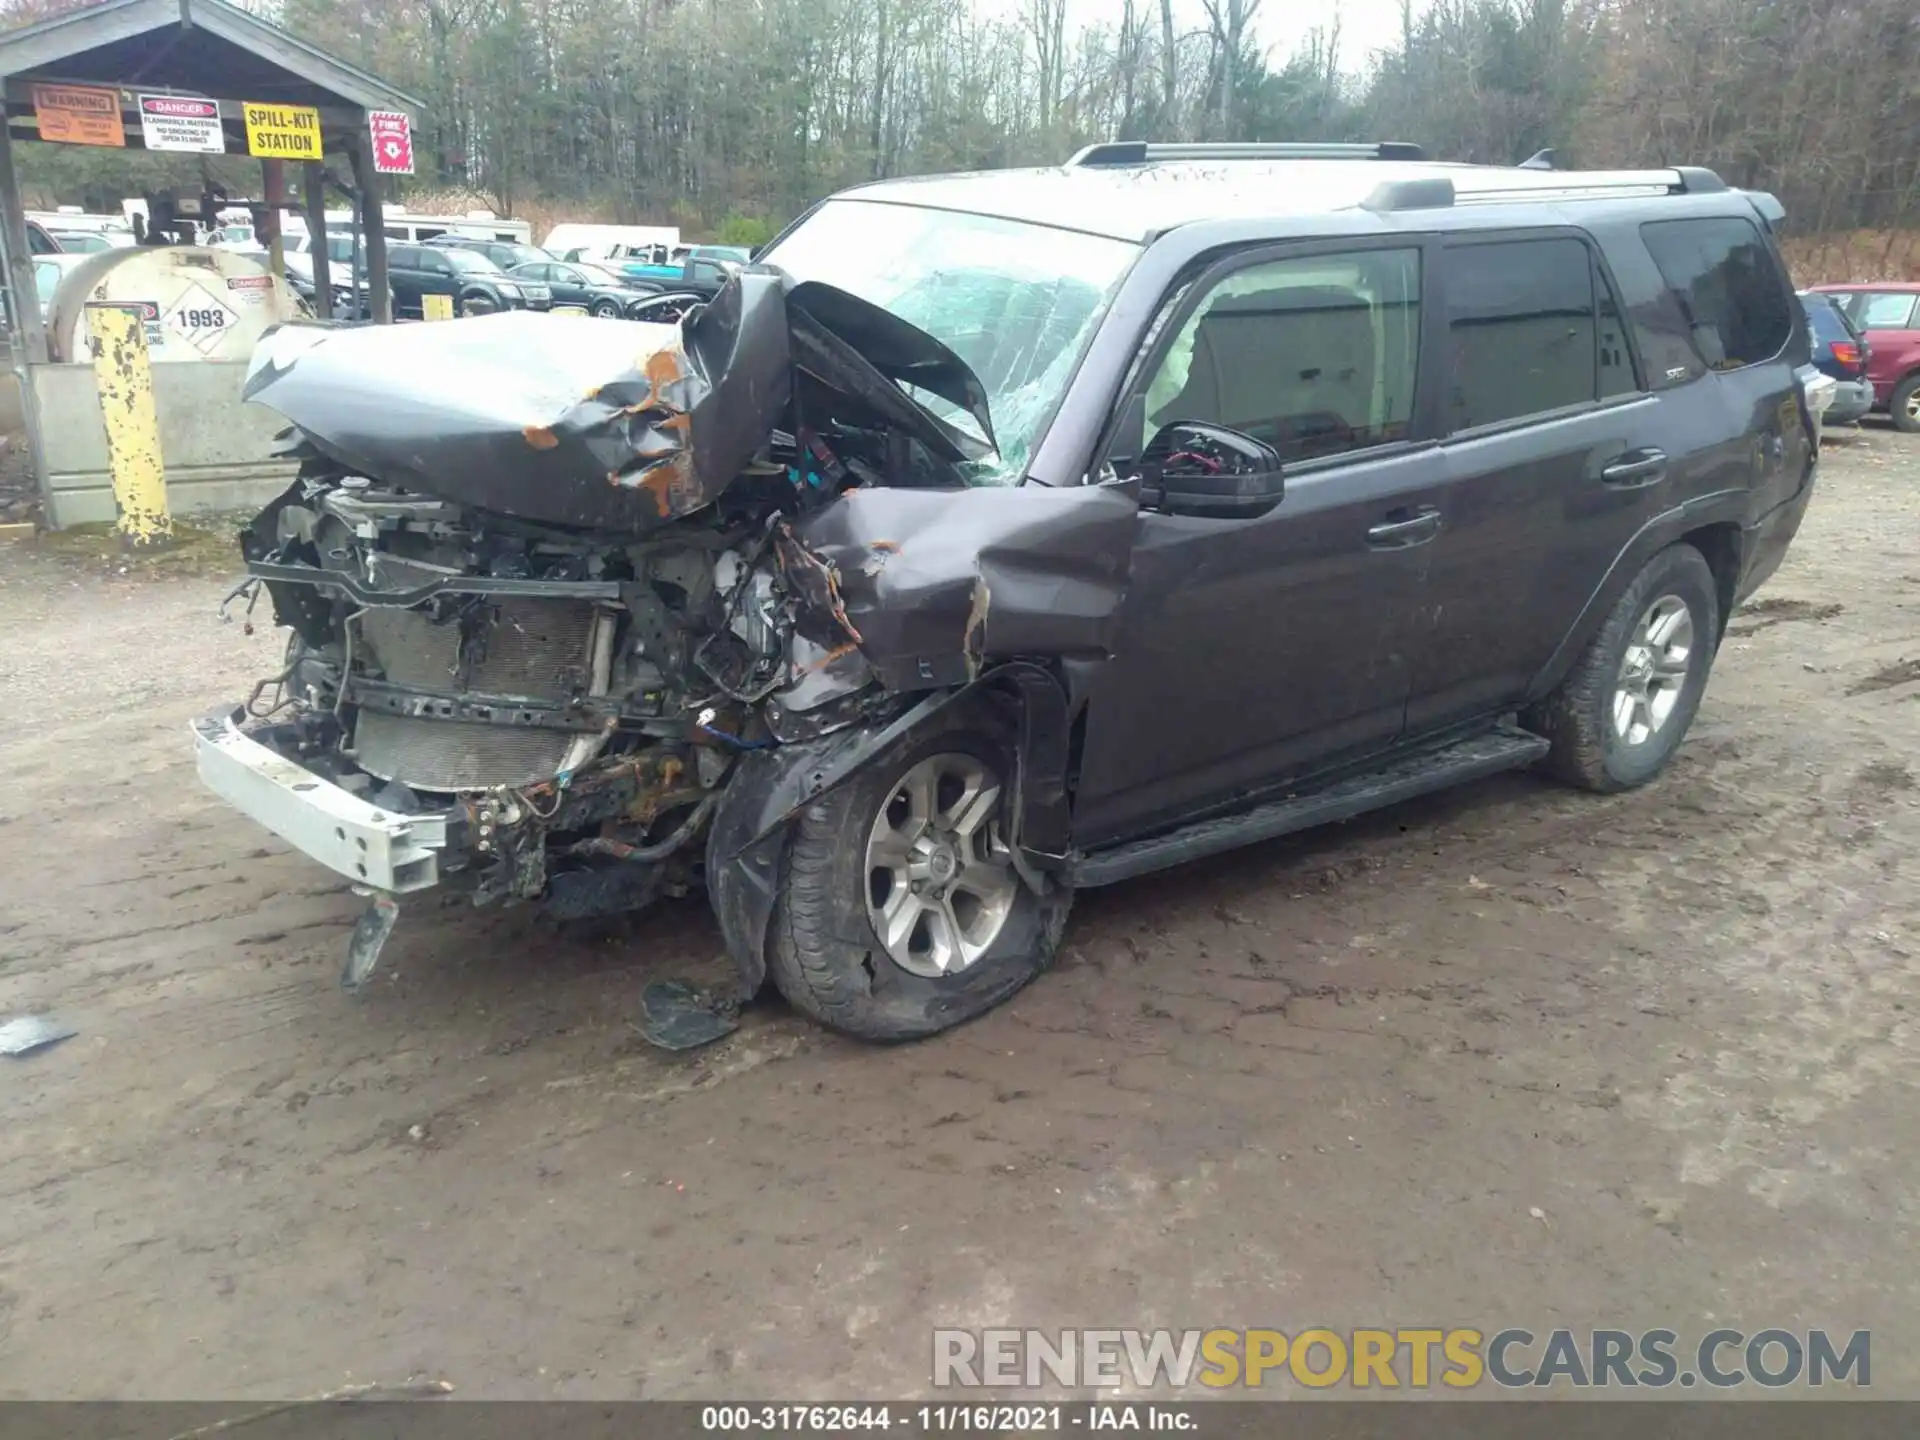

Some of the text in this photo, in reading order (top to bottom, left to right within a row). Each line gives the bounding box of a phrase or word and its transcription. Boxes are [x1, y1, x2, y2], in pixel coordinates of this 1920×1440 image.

[45, 94, 107, 110] WARNING
[155, 101, 204, 114] DANGER
[249, 109, 314, 129] SPILL-KIT
[257, 133, 313, 151] STATION
[177, 310, 225, 328] 1993
